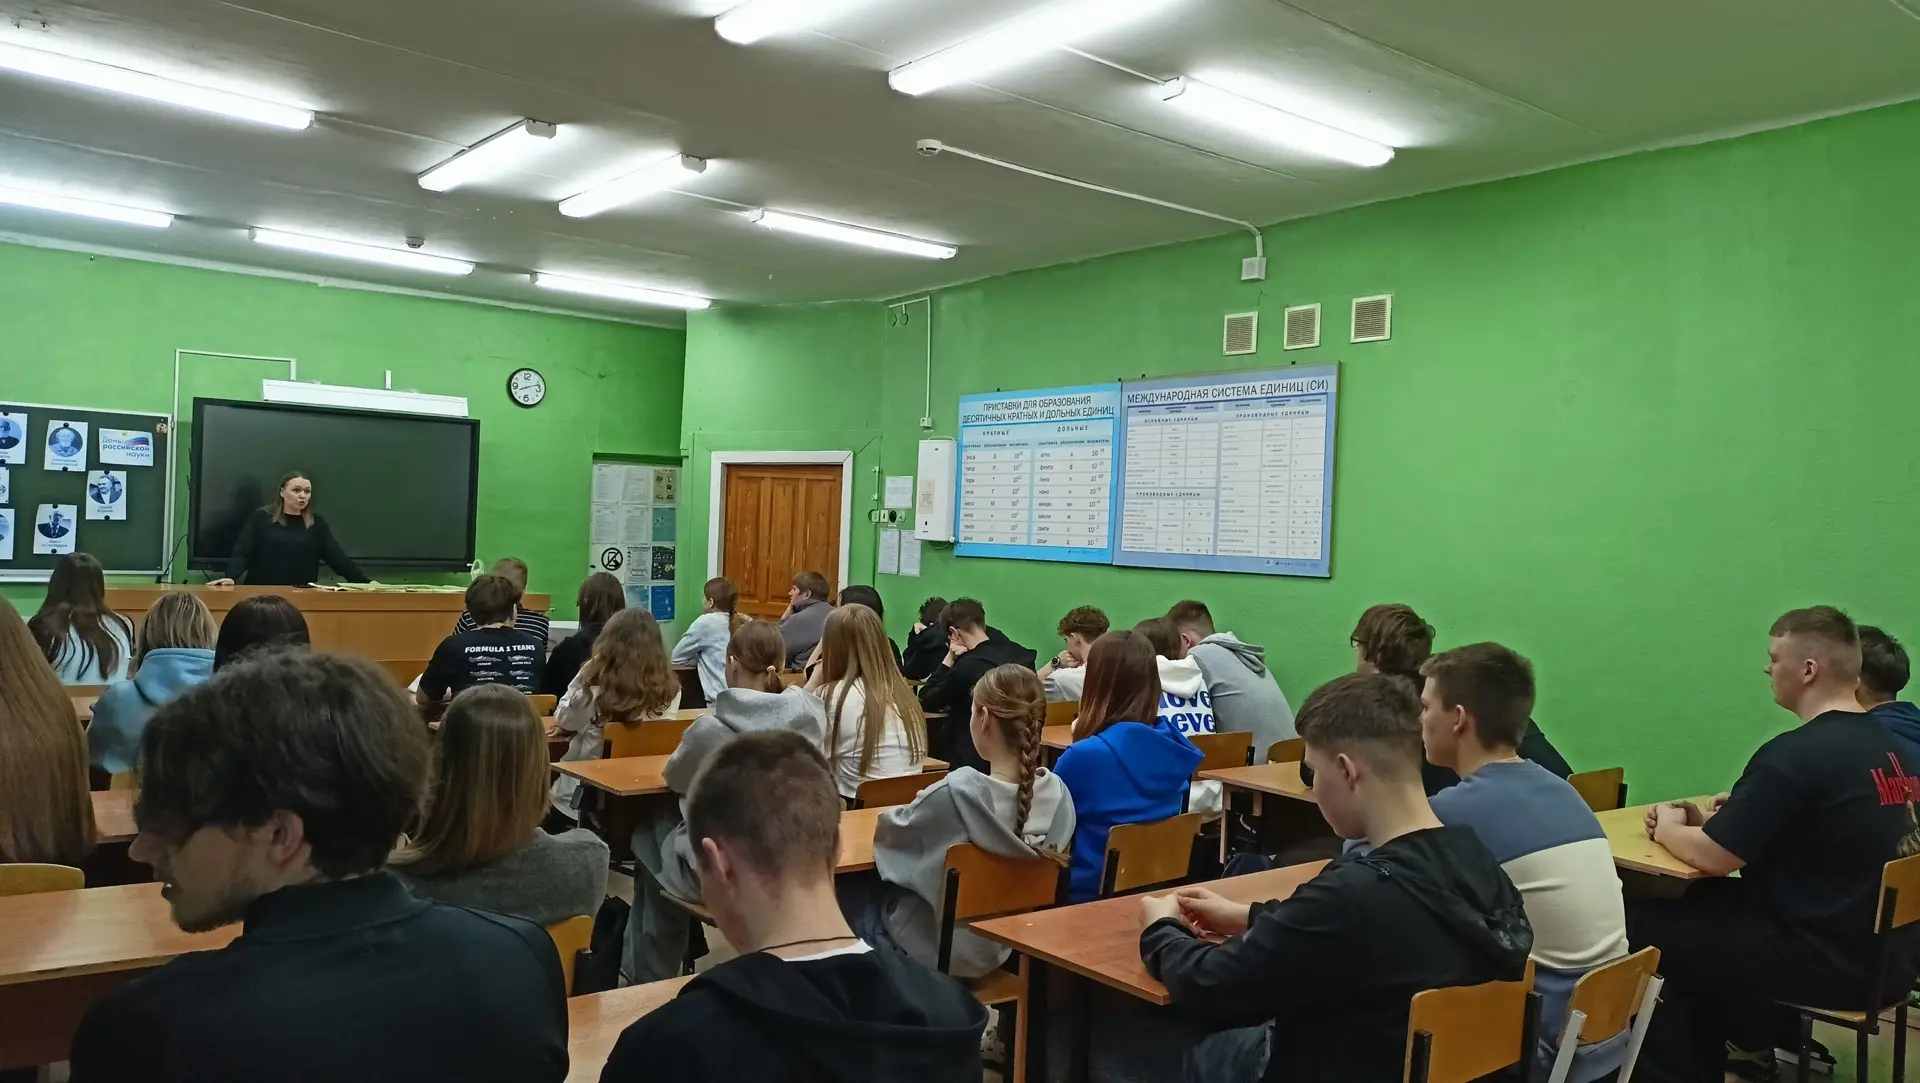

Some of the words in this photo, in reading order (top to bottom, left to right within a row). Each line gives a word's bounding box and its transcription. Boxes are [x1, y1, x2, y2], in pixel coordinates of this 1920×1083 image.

[524, 372, 531, 381] 12
[512, 382, 519, 390] 9
[1127, 388, 1209, 404] МЕЖДУНАРОДНАЯ
[1211, 385, 1257, 398] СИСТЕМА
[1260, 381, 1304, 396] ЕДИНИЦ
[1306, 379, 1329, 392] (СИ)
[523, 394, 529, 402] 6
[983, 401, 1022, 412] ПРИСТАВКИ
[1023, 399, 1037, 410] ДЛЯ
[1038, 396, 1092, 408] ОБРАЗОВАНИЯ
[962, 413, 1007, 424] ДЕСЯТИЧНЫХ
[1008, 410, 1038, 421] КРАТНЫХ
[1040, 410, 1045, 419] И
[1045, 407, 1082, 420] ДОЛЬНЫХ
[1083, 405, 1115, 417] ЕДИНИЦ
[102, 436, 122, 444] День
[102, 443, 150, 452] российской
[126, 452, 150, 460] науки
[464, 645, 505, 653] FORMULA
